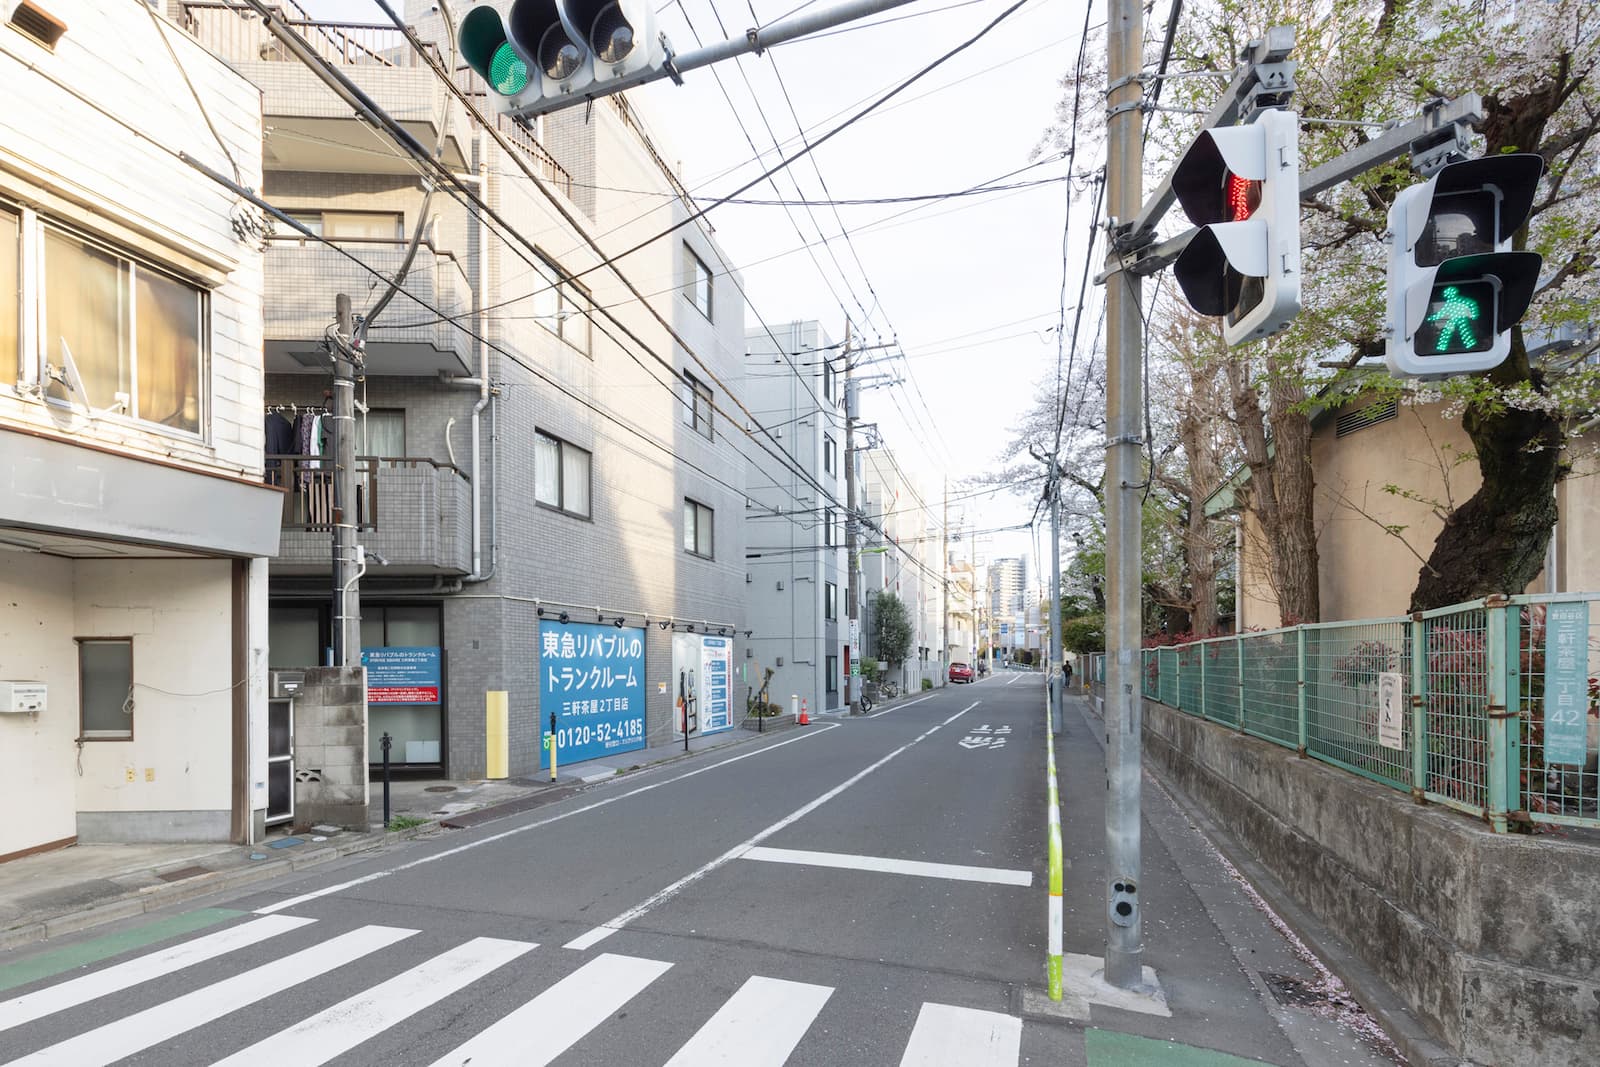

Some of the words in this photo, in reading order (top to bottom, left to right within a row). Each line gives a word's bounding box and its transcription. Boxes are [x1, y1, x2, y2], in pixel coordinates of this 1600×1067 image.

[542, 630, 642, 659] 東急リバブルの
[548, 665, 638, 693] トランクルーム
[562, 697, 629, 716] 三軒茶屋2丁目店
[1550, 709, 1580, 726] 42
[557, 718, 643, 748] 0120-52-4185
